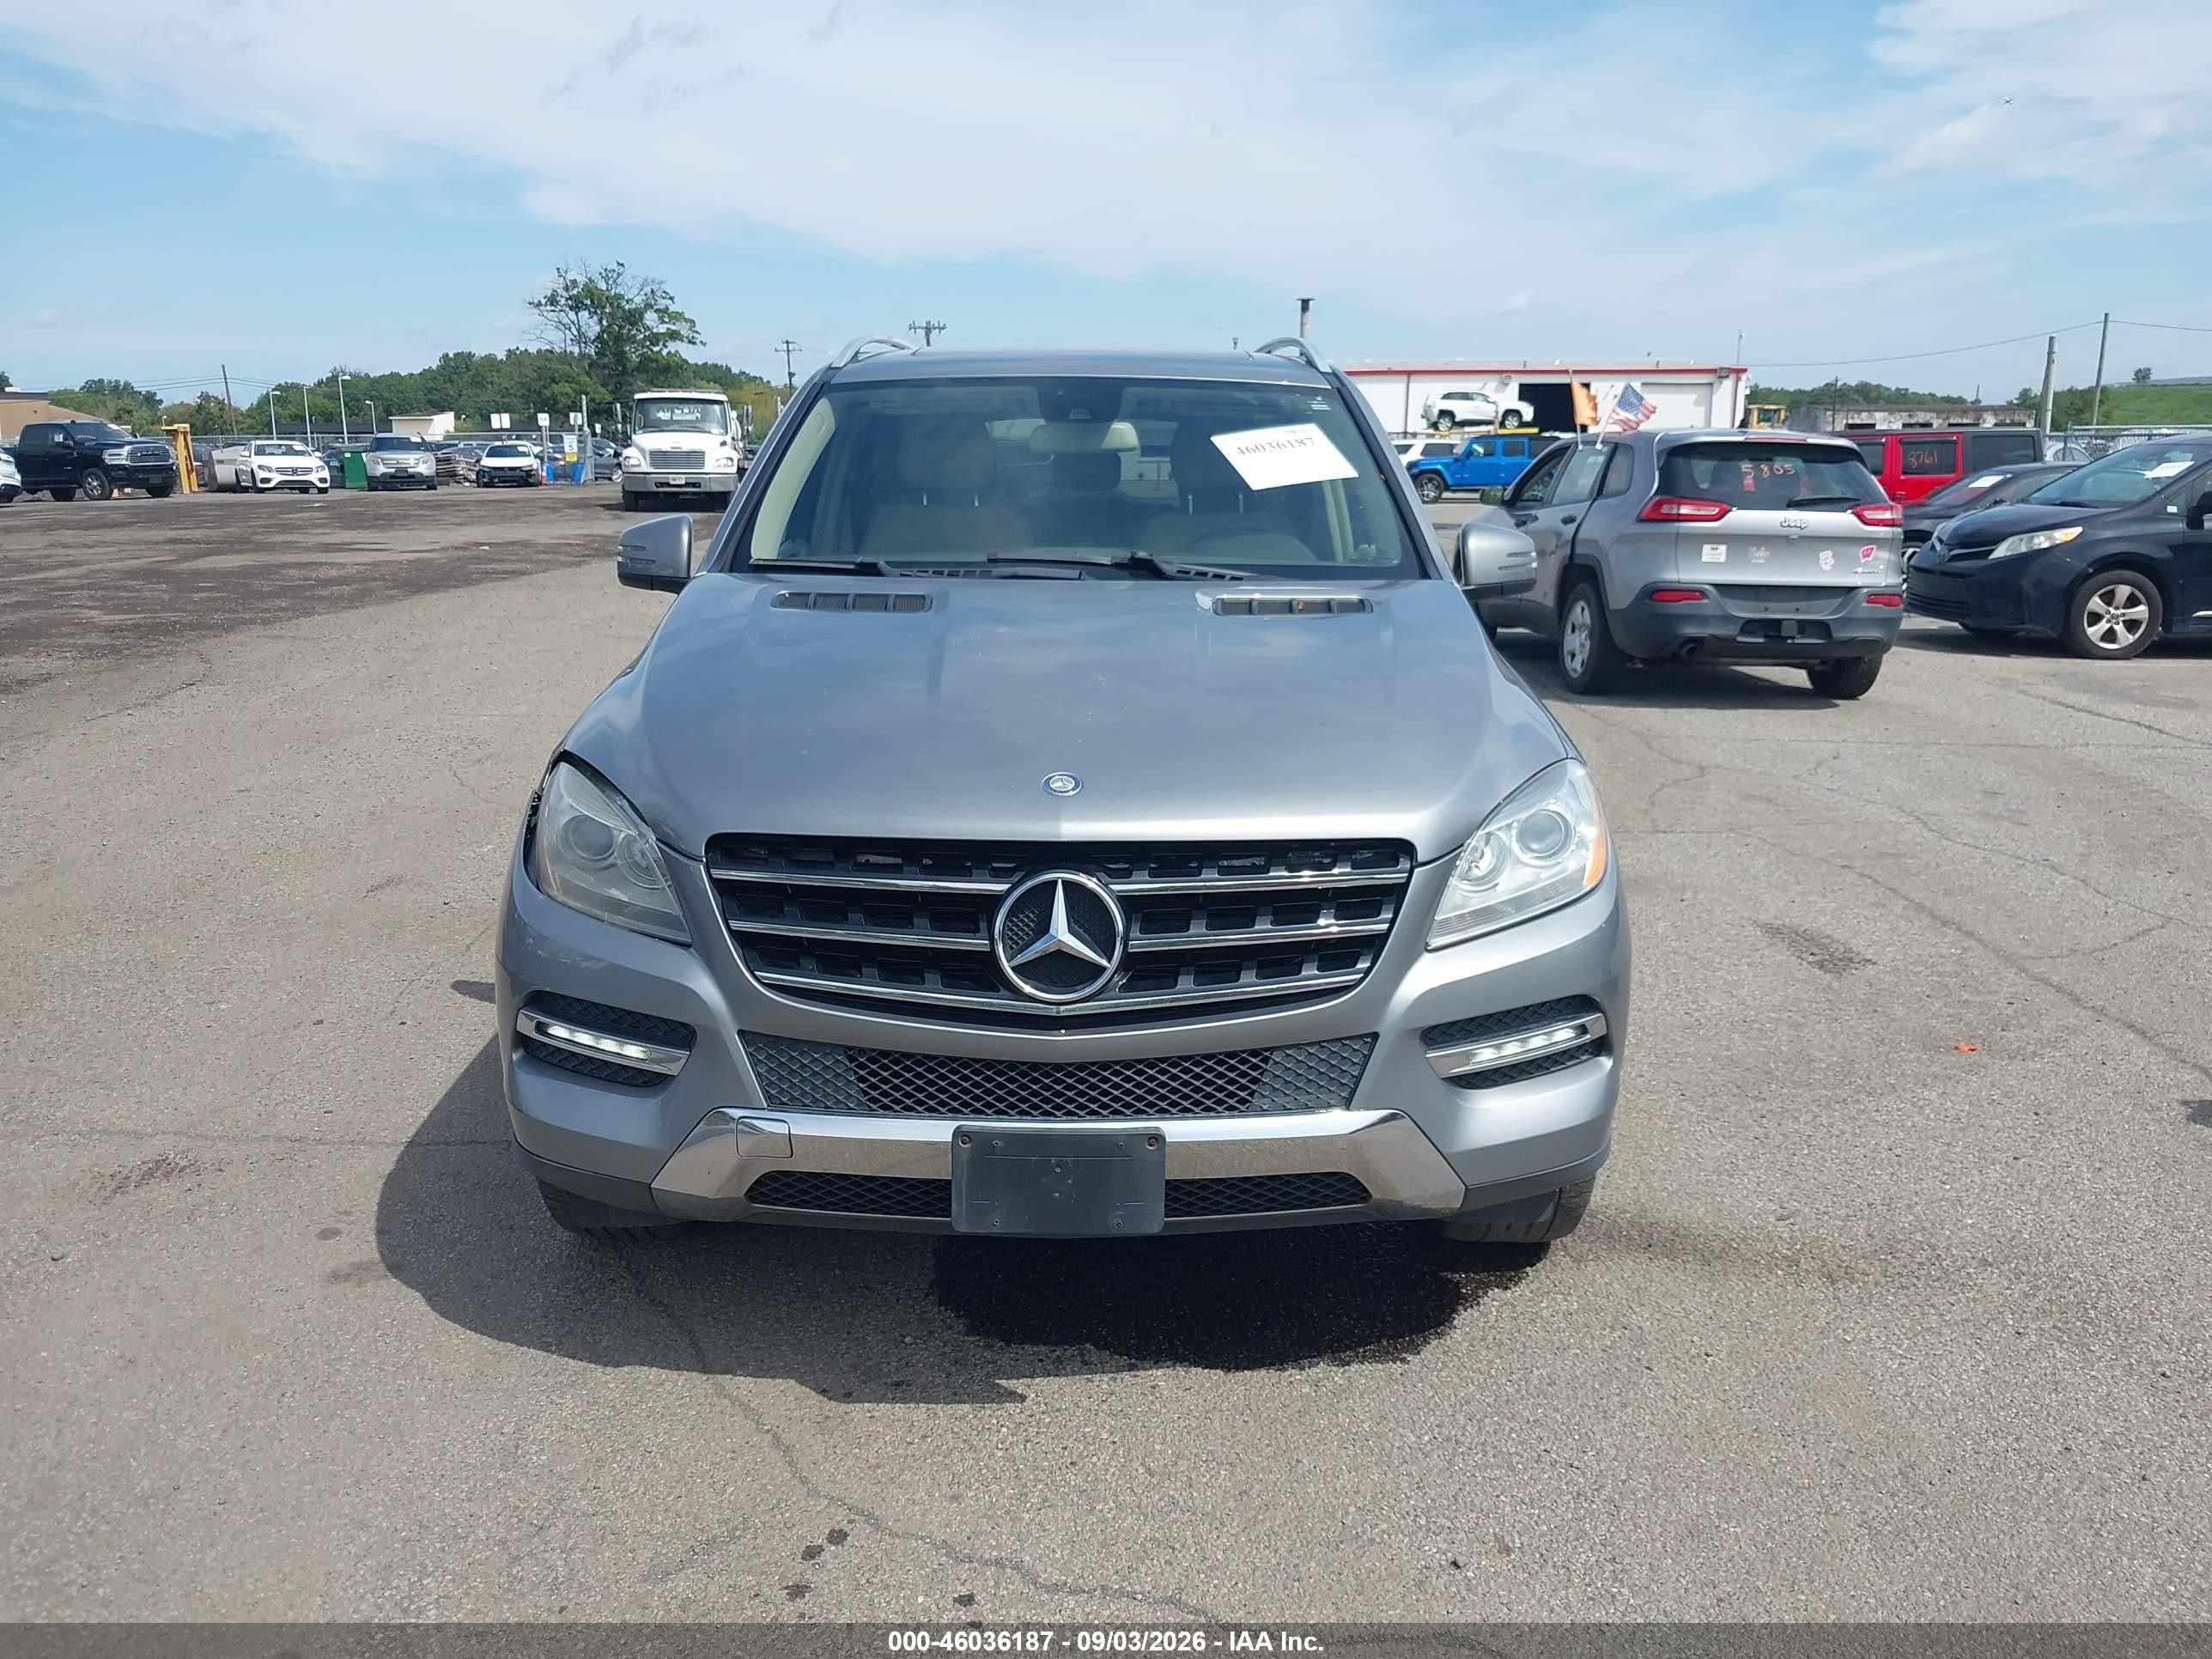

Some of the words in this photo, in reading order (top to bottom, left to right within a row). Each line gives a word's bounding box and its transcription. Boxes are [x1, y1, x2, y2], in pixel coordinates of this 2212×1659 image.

[1237, 437, 1315, 455] 46036187
[1908, 451, 1937, 469] 8761
[1741, 464, 1795, 479] 5805
[1779, 515, 1808, 531] Jeep
